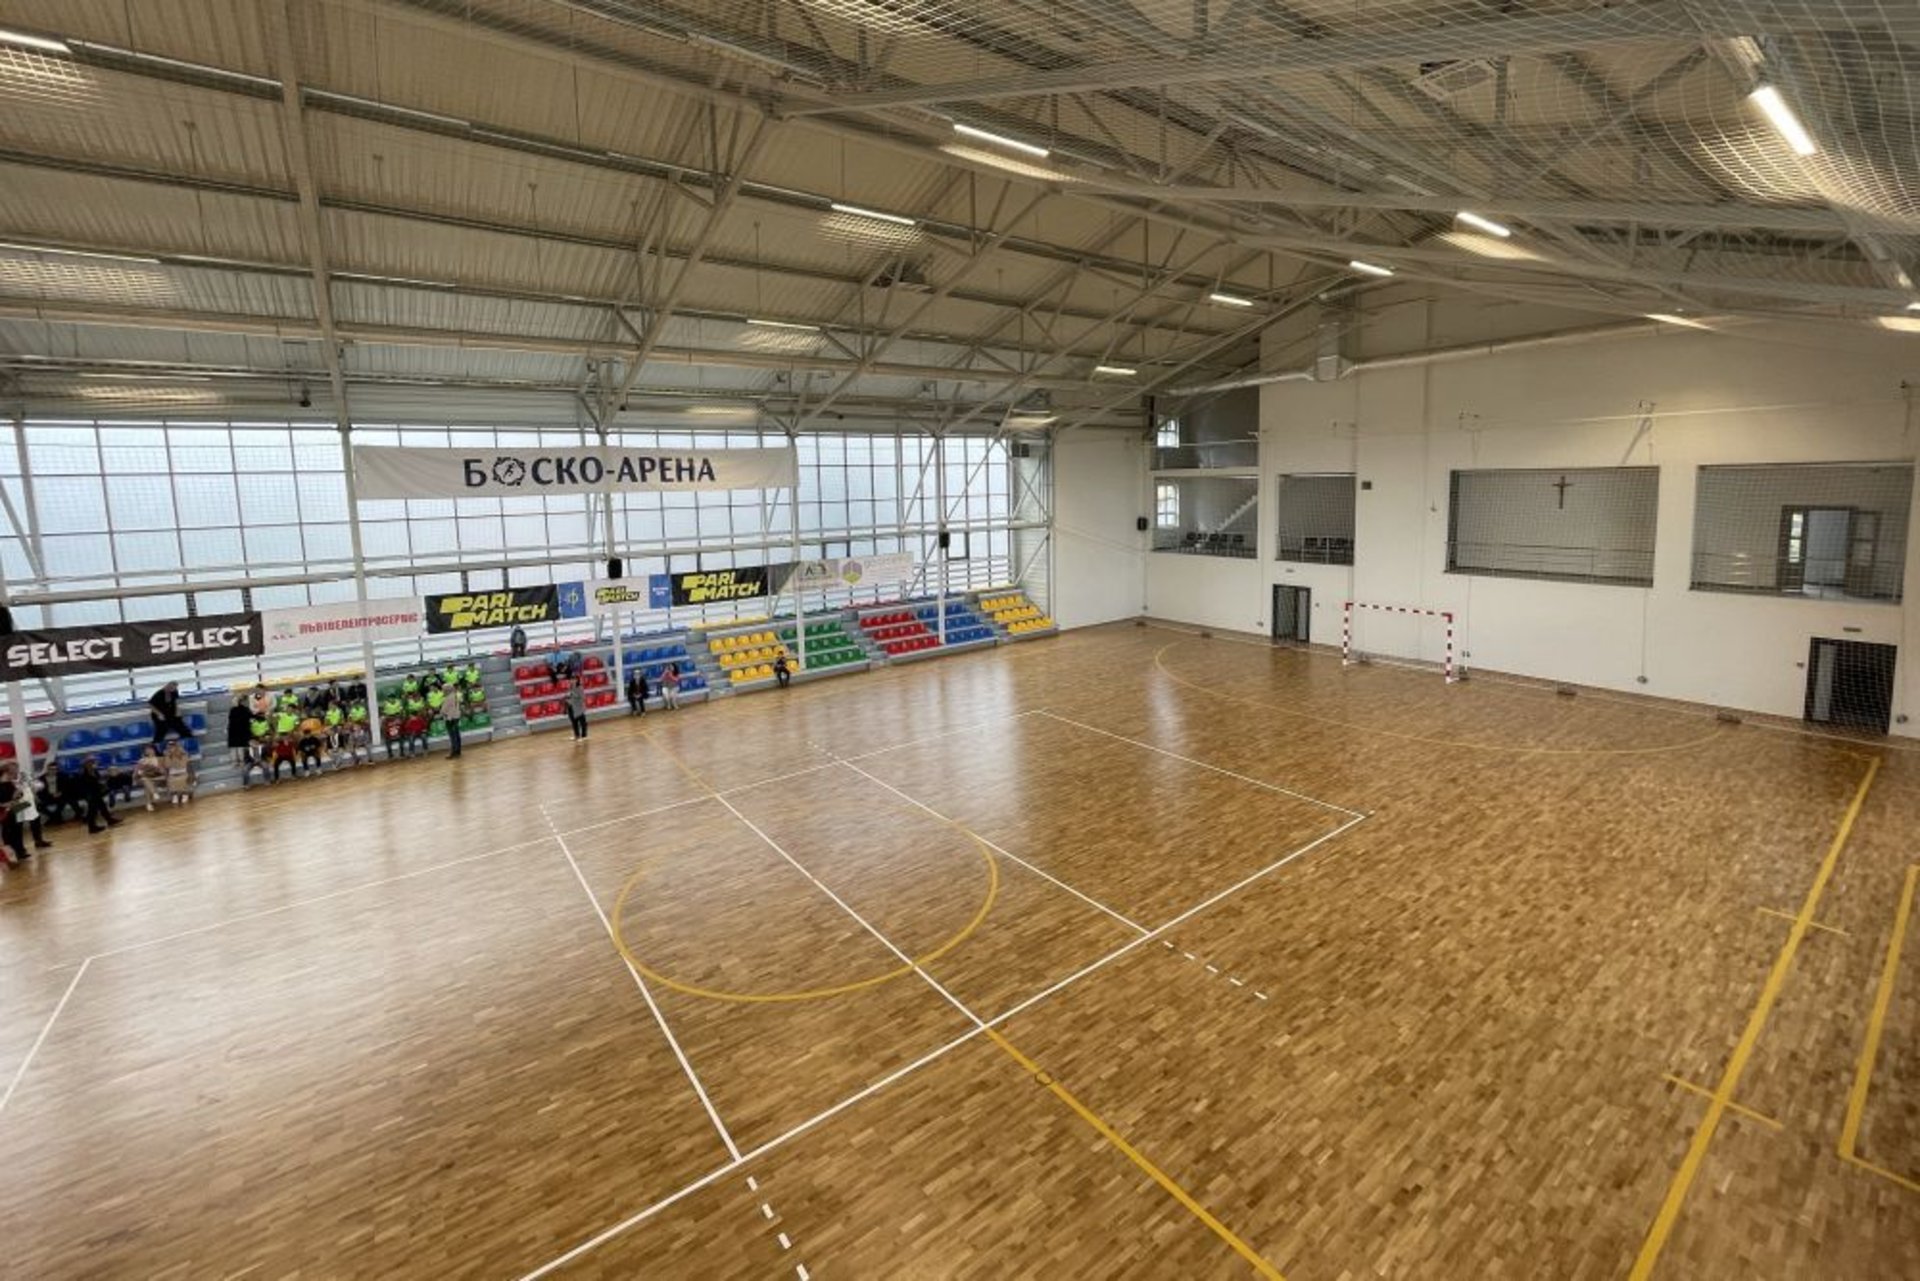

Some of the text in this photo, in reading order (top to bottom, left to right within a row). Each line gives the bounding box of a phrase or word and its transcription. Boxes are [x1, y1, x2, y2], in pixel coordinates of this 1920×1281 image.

[682, 571, 736, 590] PARI
[689, 581, 760, 602] MATCH
[440, 592, 514, 613] PARI
[451, 602, 548, 628] MATCH
[7, 624, 252, 668] SELECT SELECT
